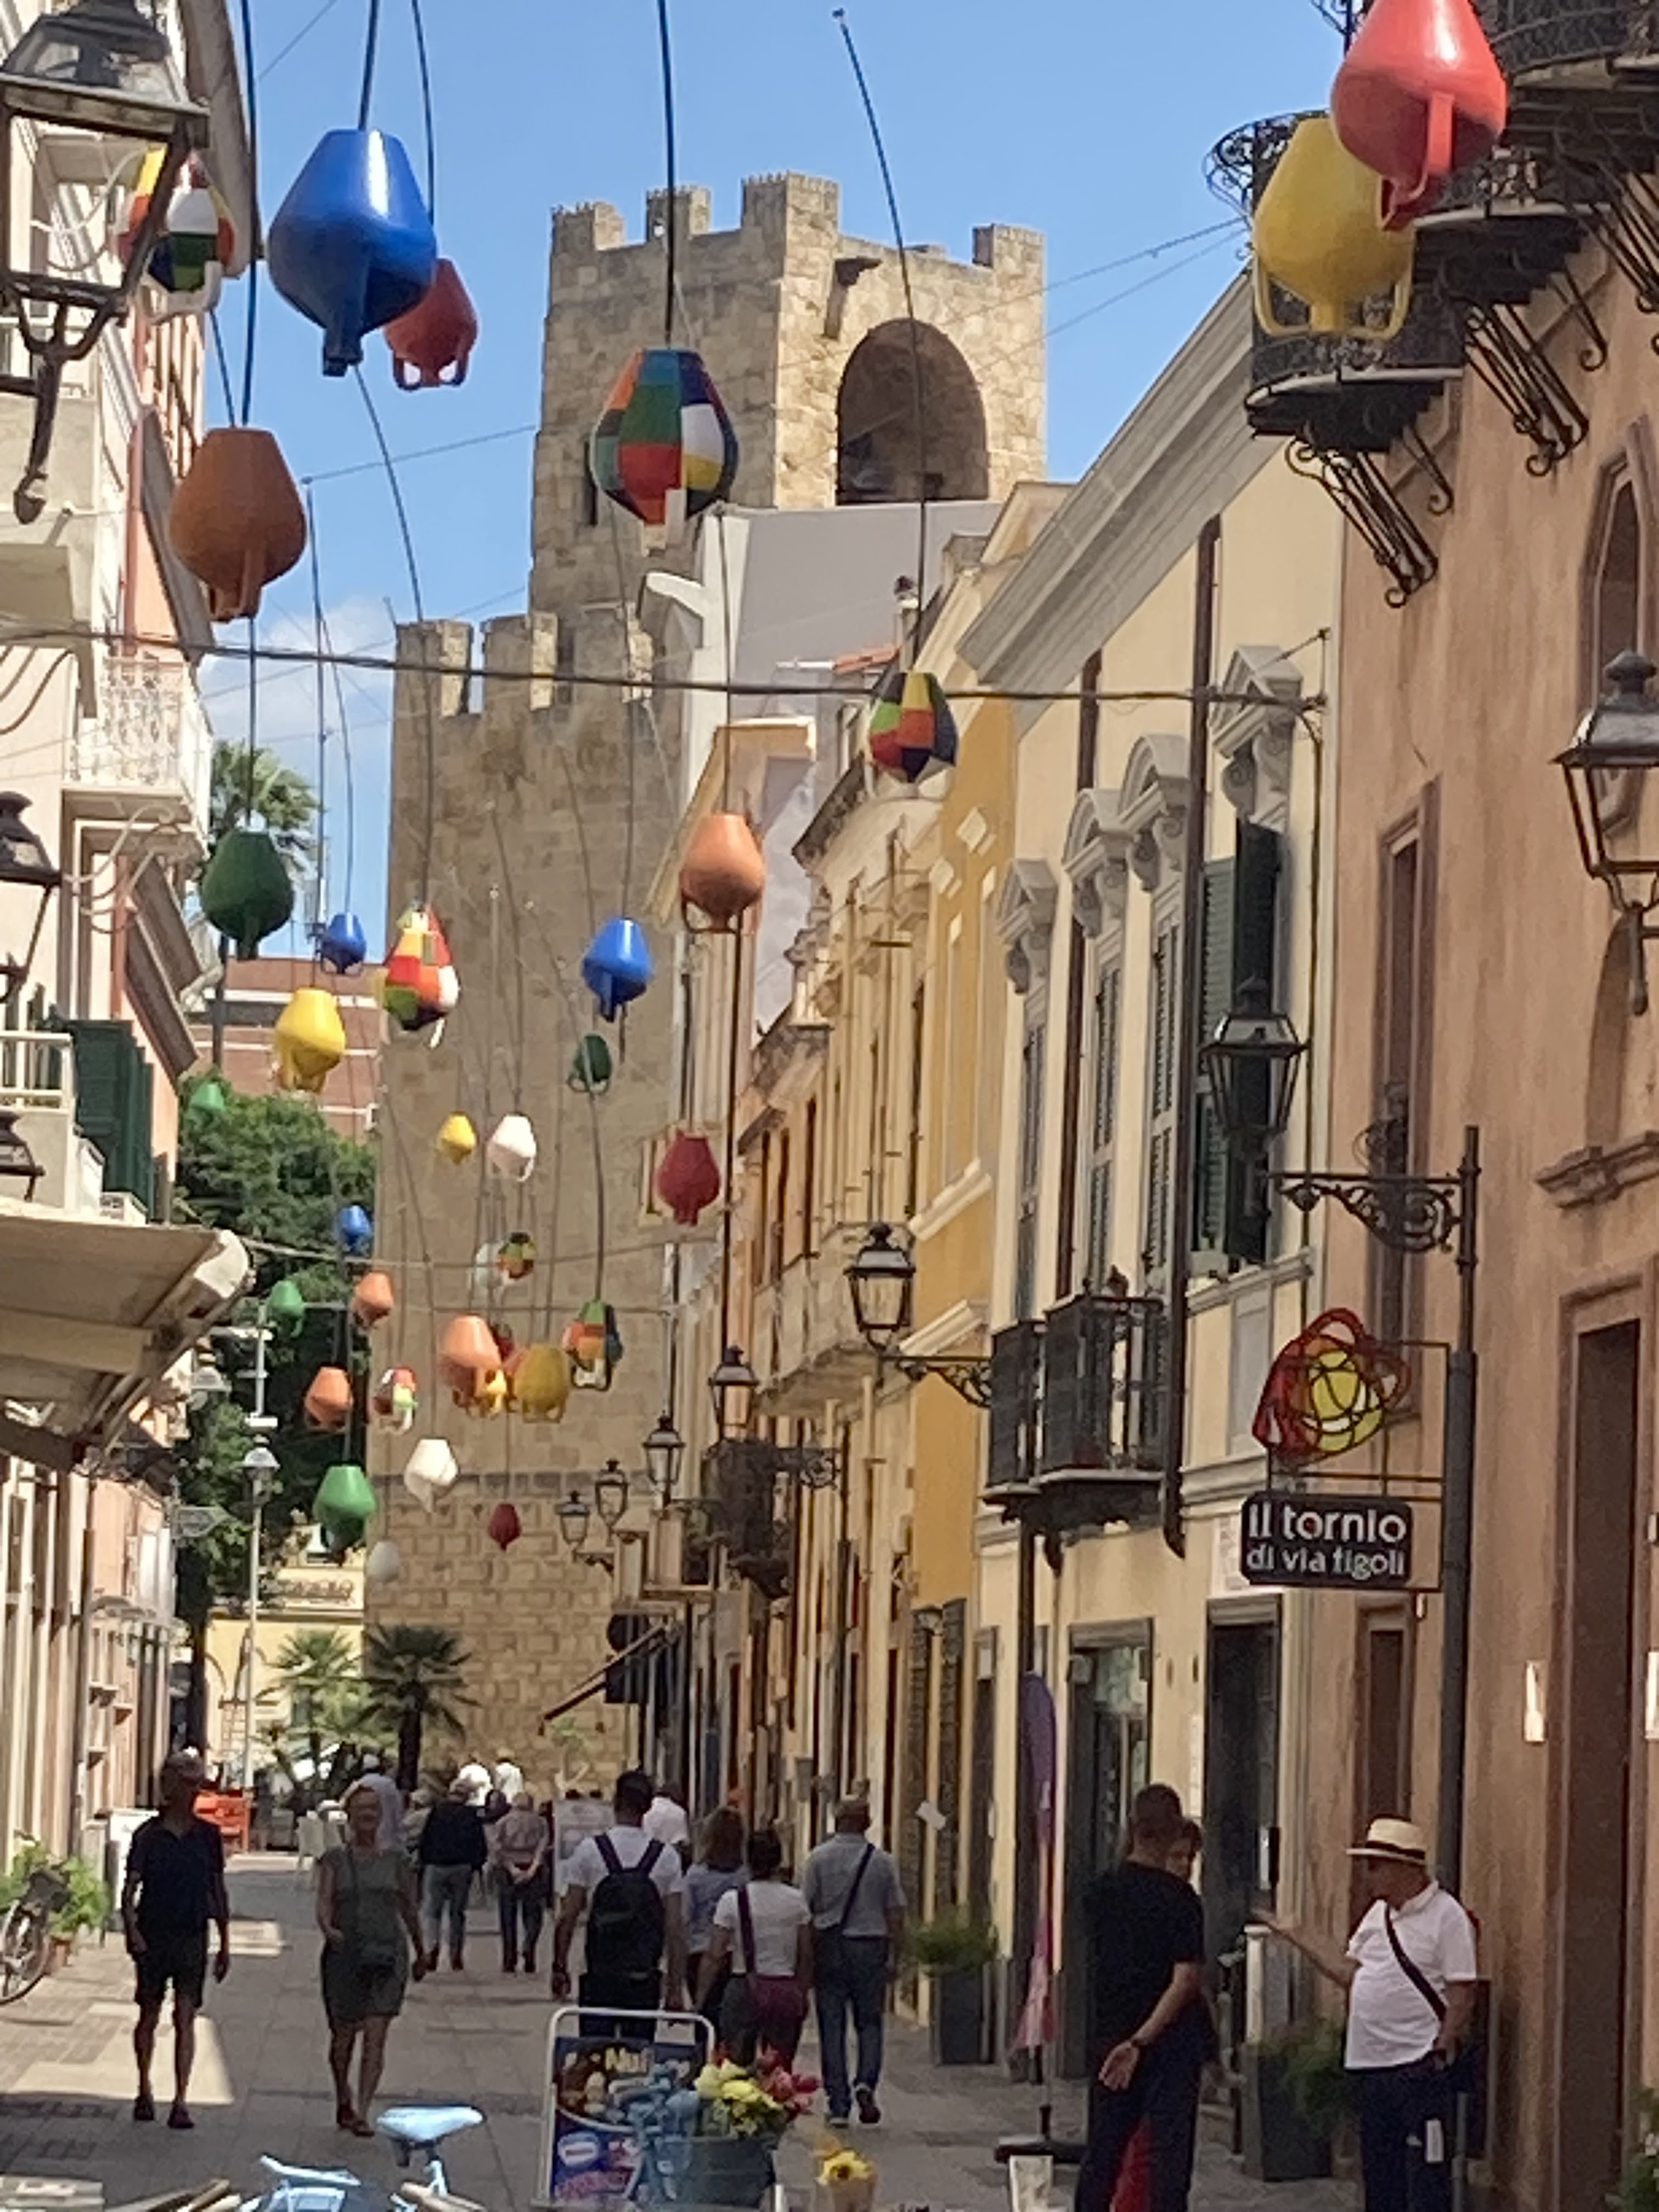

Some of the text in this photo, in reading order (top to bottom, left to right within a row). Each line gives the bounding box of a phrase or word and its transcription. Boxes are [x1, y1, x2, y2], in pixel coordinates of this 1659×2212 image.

[1249, 1503, 1407, 1543] Il tornio
[1246, 1543, 1274, 1570] di
[1282, 1547, 1326, 1572] via
